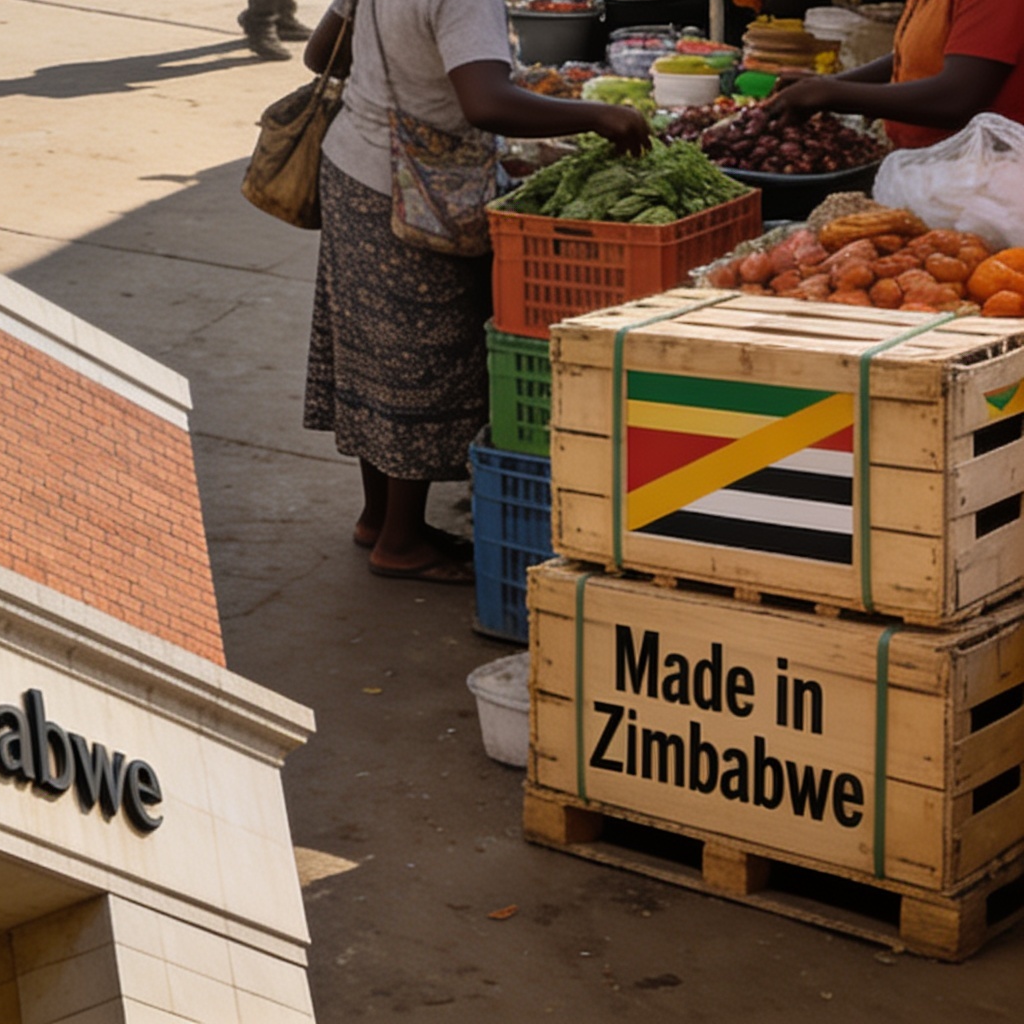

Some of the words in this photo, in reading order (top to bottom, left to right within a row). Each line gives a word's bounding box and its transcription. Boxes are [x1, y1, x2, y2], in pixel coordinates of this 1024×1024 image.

[615, 624, 755, 718] Made
[776, 656, 824, 735] in
[589, 701, 865, 829] Zimbabwe
